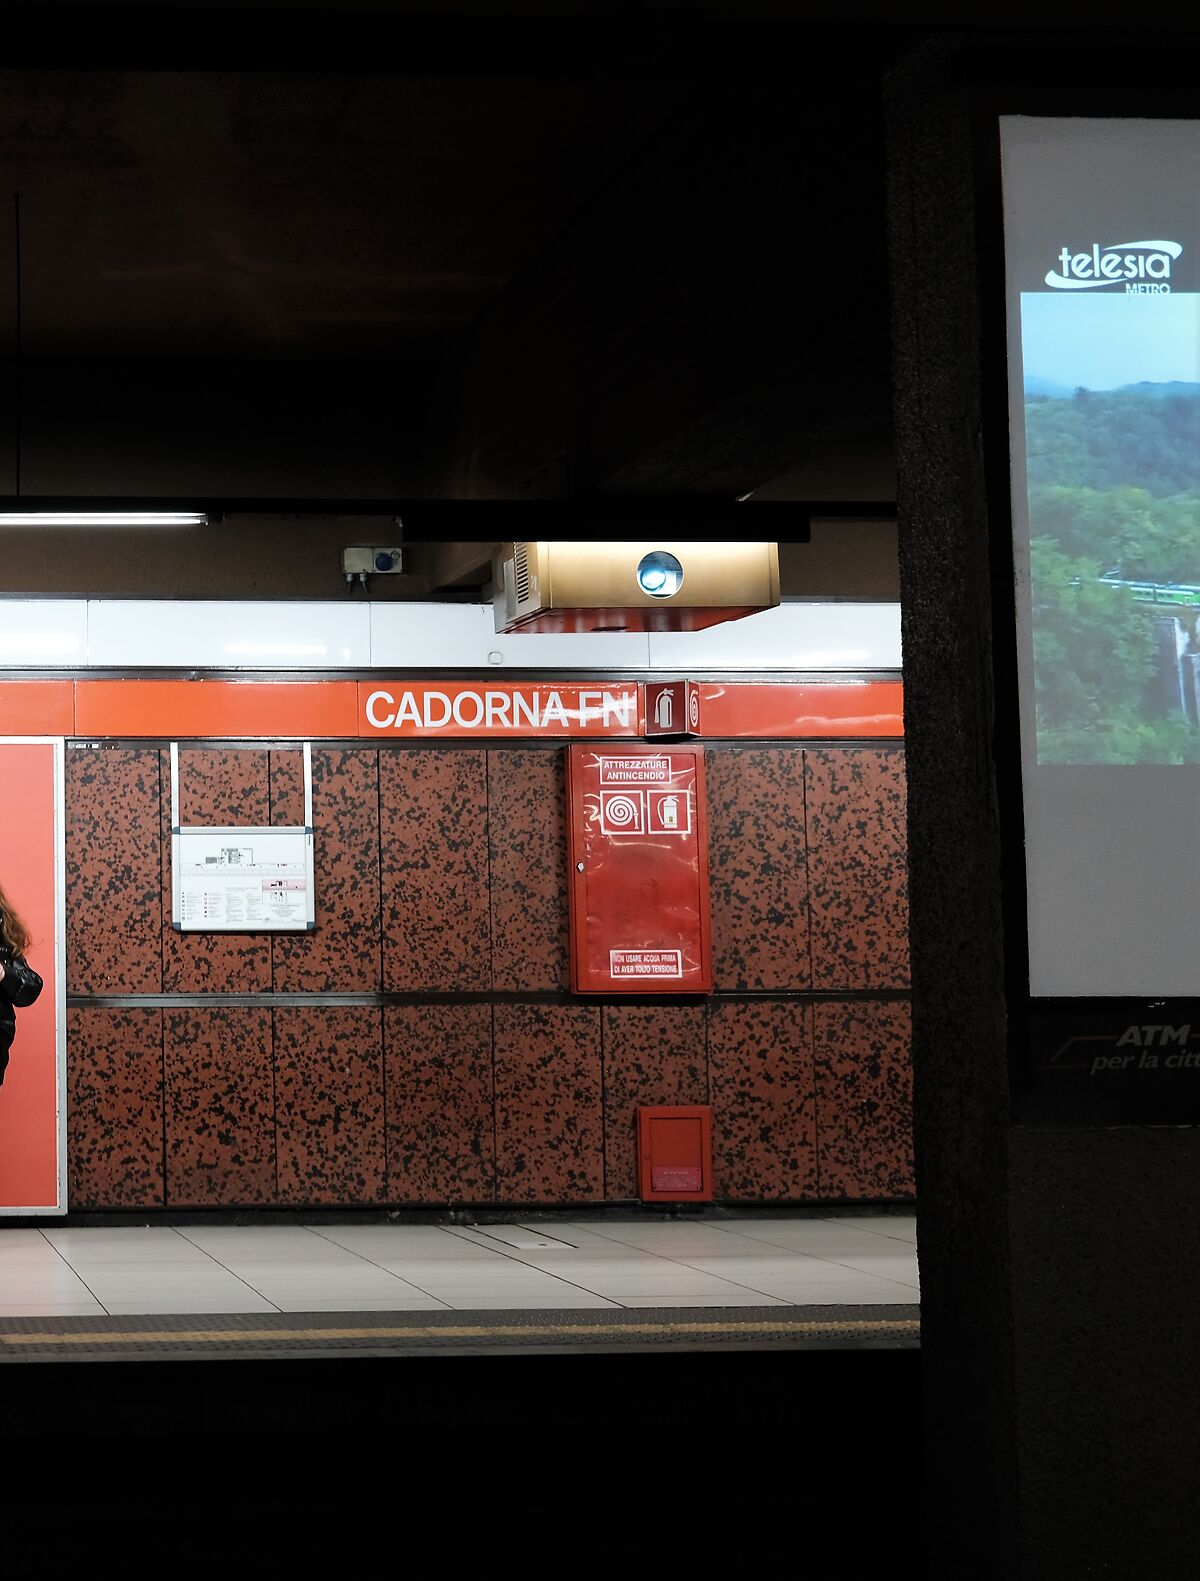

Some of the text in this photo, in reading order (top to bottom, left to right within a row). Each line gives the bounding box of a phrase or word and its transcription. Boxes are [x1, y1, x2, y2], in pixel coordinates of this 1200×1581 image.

[1058, 243, 1171, 278] telesia
[1125, 282, 1171, 294] METRO
[365, 690, 629, 728] CADORNA FN
[604, 760, 667, 769] ATTREZZATURE
[606, 771, 665, 780] ANTINCENDIO
[1115, 1024, 1191, 1046] ATM
[1090, 1055, 1136, 1075] per
[1138, 1050, 1159, 1069] la
